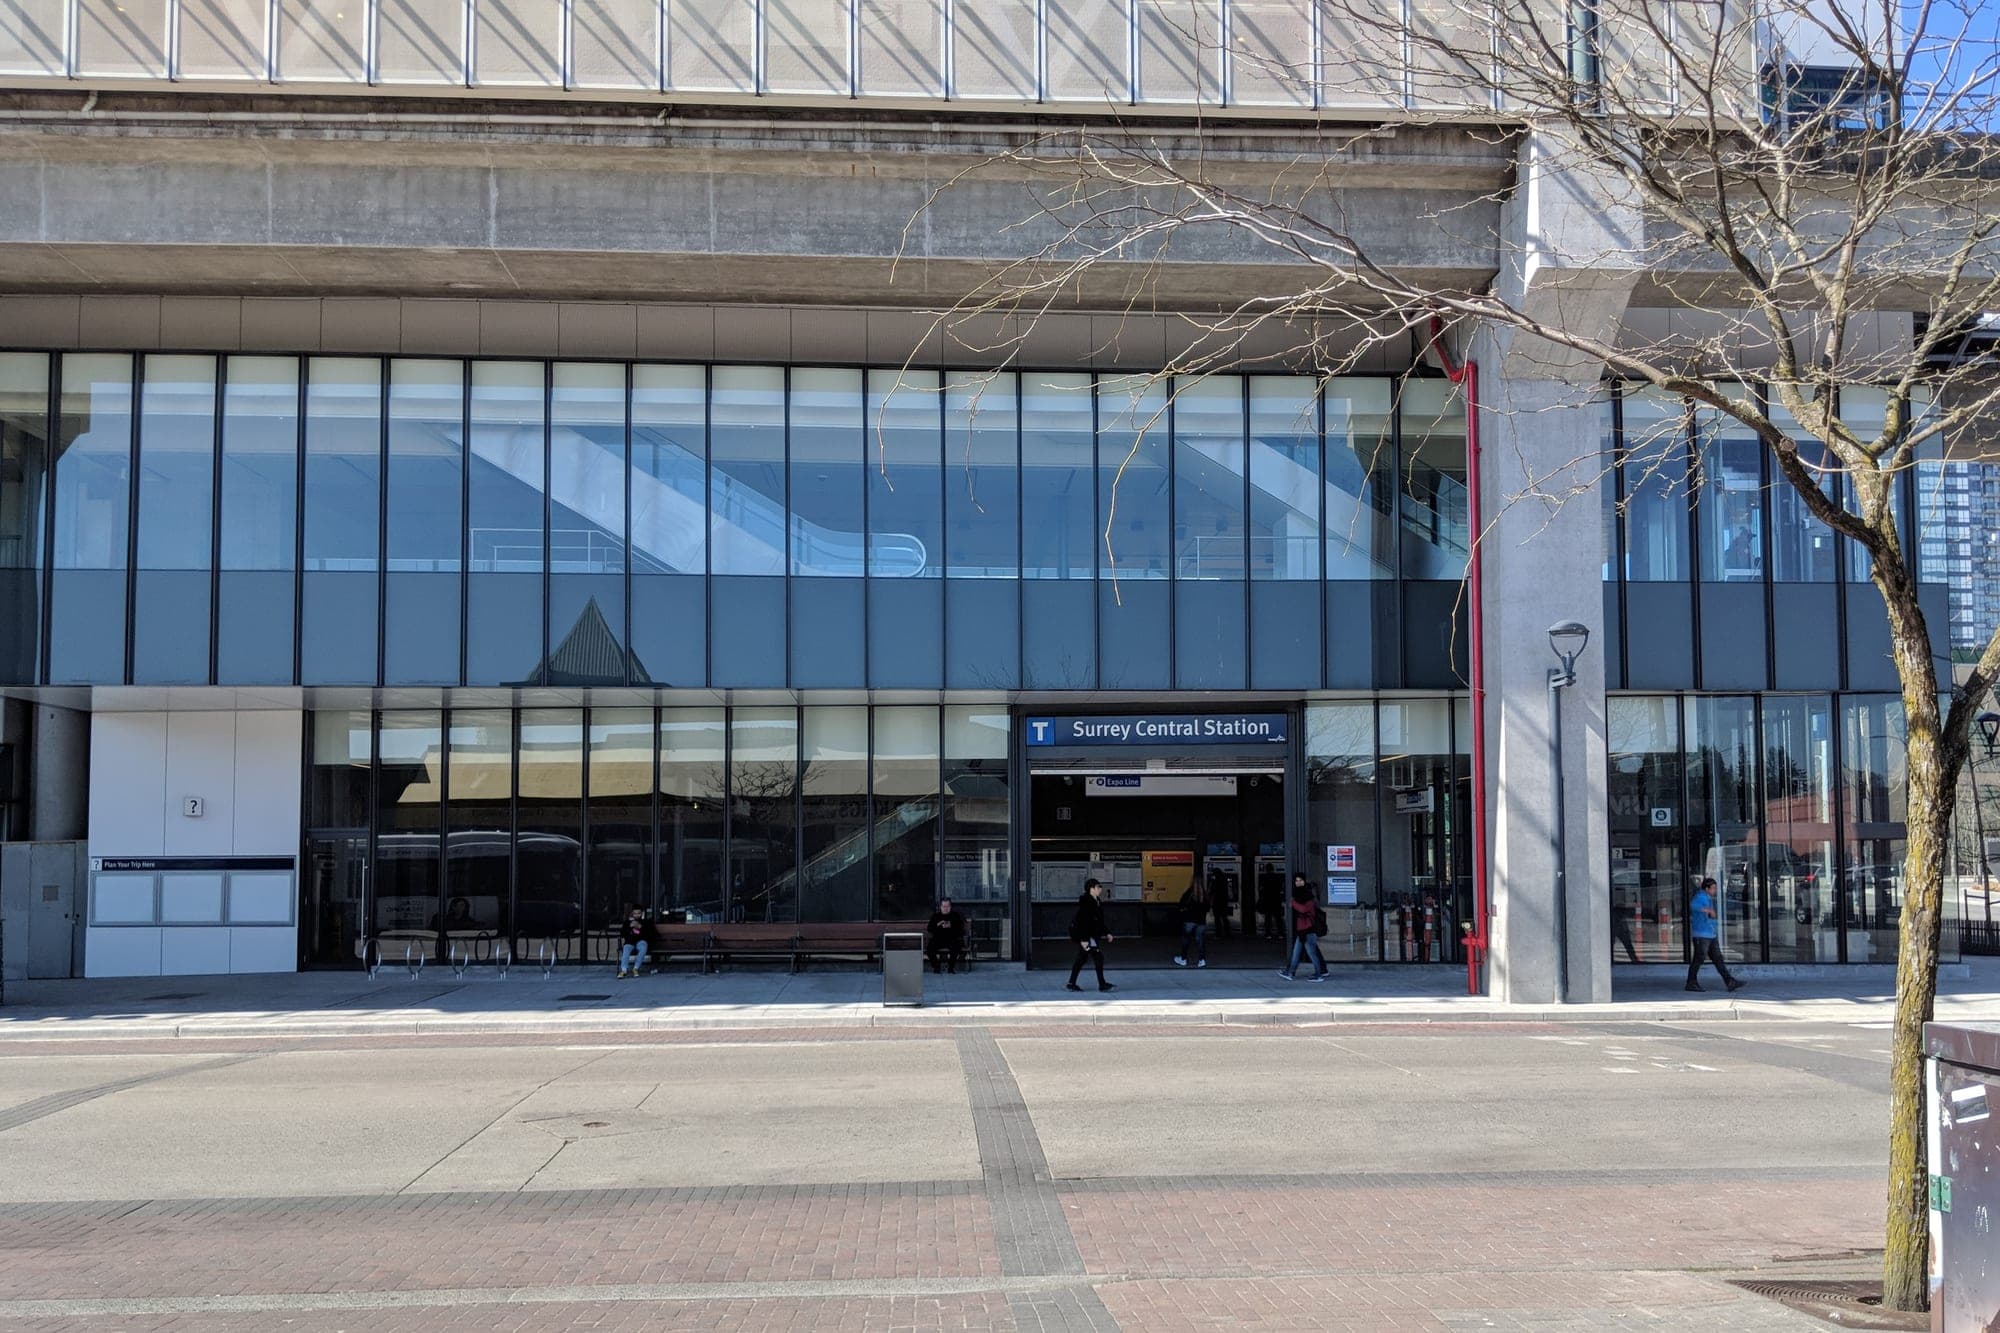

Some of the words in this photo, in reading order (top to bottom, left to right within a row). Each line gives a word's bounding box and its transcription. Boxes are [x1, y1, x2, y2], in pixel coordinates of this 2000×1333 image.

[1032, 721, 1048, 741] T
[1073, 721, 1131, 741] Surrey
[1135, 720, 1199, 737] Central
[1204, 719, 1270, 736] Station
[1107, 778, 1124, 787] Expo
[1125, 778, 1139, 786] Line
[130, 861, 142, 869] Trip
